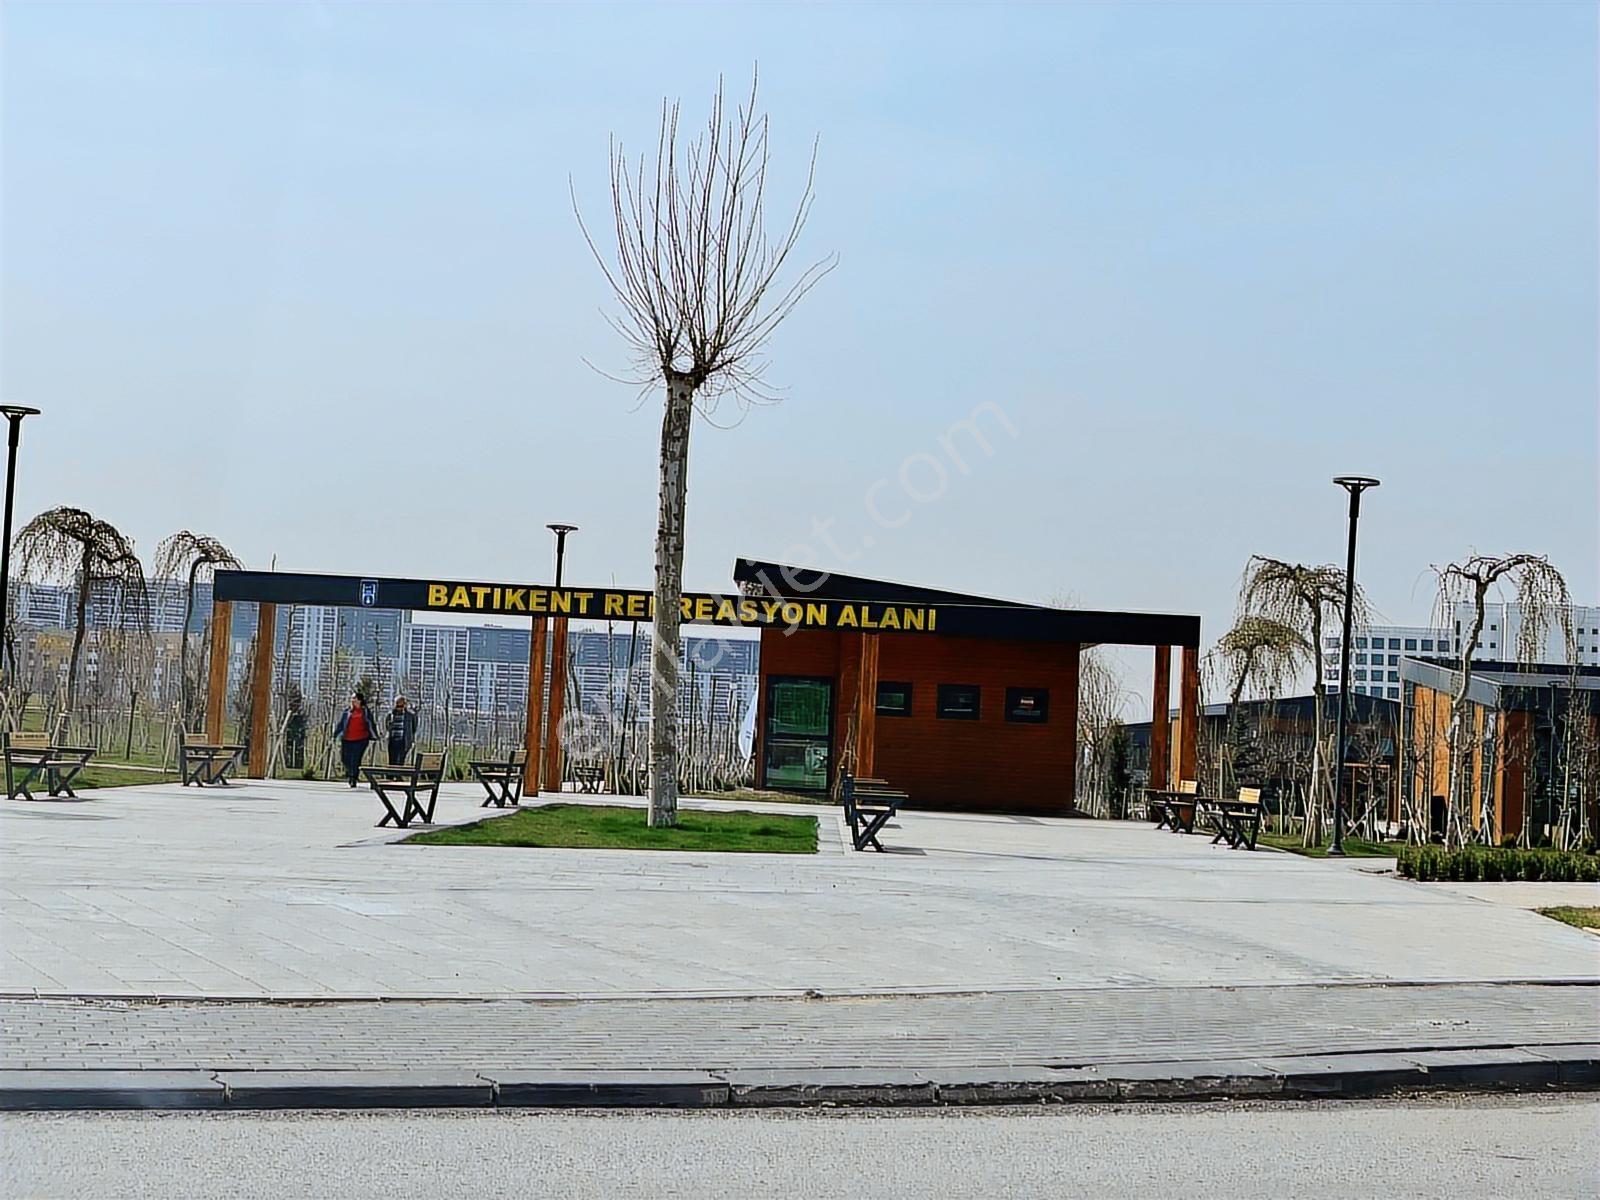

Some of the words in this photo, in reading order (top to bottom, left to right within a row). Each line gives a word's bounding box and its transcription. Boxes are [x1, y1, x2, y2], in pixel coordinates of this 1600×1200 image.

[427, 583, 594, 614] BATIKENT
[603, 593, 827, 626] REREASYON
[836, 604, 936, 631] ALANI
